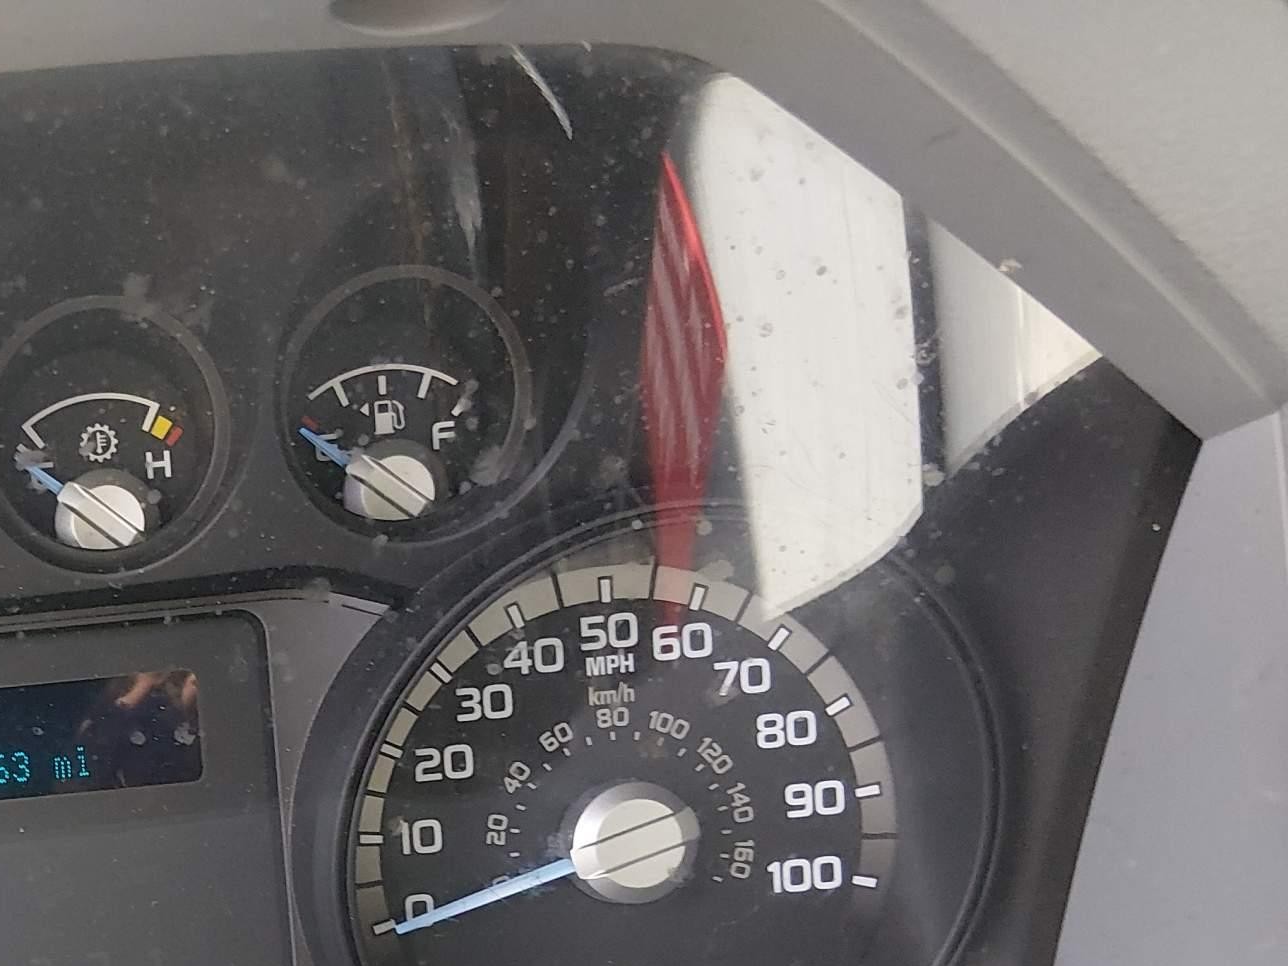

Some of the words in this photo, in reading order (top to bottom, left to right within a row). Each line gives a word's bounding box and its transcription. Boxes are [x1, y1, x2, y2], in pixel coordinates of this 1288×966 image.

[432, 421, 456, 450] F
[145, 449, 172, 479] H
[579, 613, 639, 651] 50
[652, 623, 713, 661] 60
[503, 637, 565, 675] 40
[585, 655, 635, 677] MPH
[588, 683, 636, 706] km/h
[713, 658, 772, 695] 70
[455, 684, 513, 722] 30
[596, 707, 629, 729] 80
[539, 723, 574, 752] 60
[648, 711, 690, 740] 100
[755, 711, 816, 749] 80
[54, 746, 90, 780] mi
[414, 744, 474, 782] 20
[696, 737, 734, 775] 120
[503, 761, 531, 794] 40
[726, 782, 754, 824] 140
[785, 780, 846, 818] 90
[400, 819, 443, 855] 10
[487, 814, 509, 846] 20
[729, 839, 754, 879] 160
[766, 856, 842, 894] 100
